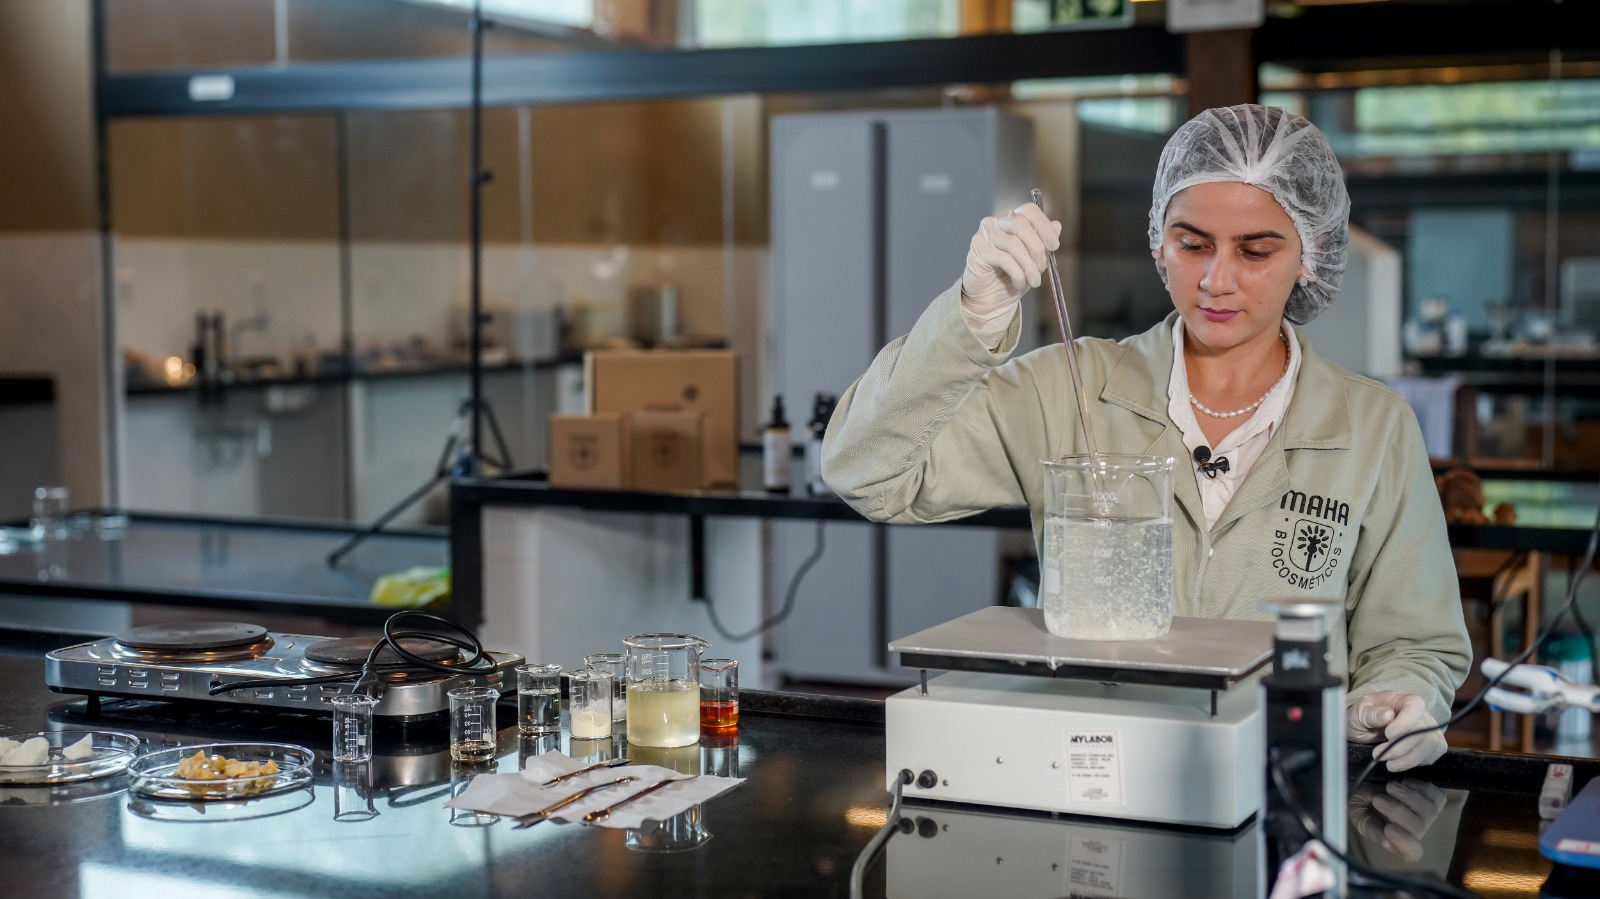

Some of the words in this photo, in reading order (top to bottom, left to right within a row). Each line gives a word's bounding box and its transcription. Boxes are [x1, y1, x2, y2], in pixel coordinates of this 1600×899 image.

[1092, 491, 1115, 501] 1000
[1280, 490, 1350, 526] MAHA
[1271, 529, 1342, 590] BIOCOSMÉTICOS
[1071, 735, 1113, 743] MYLABOR
